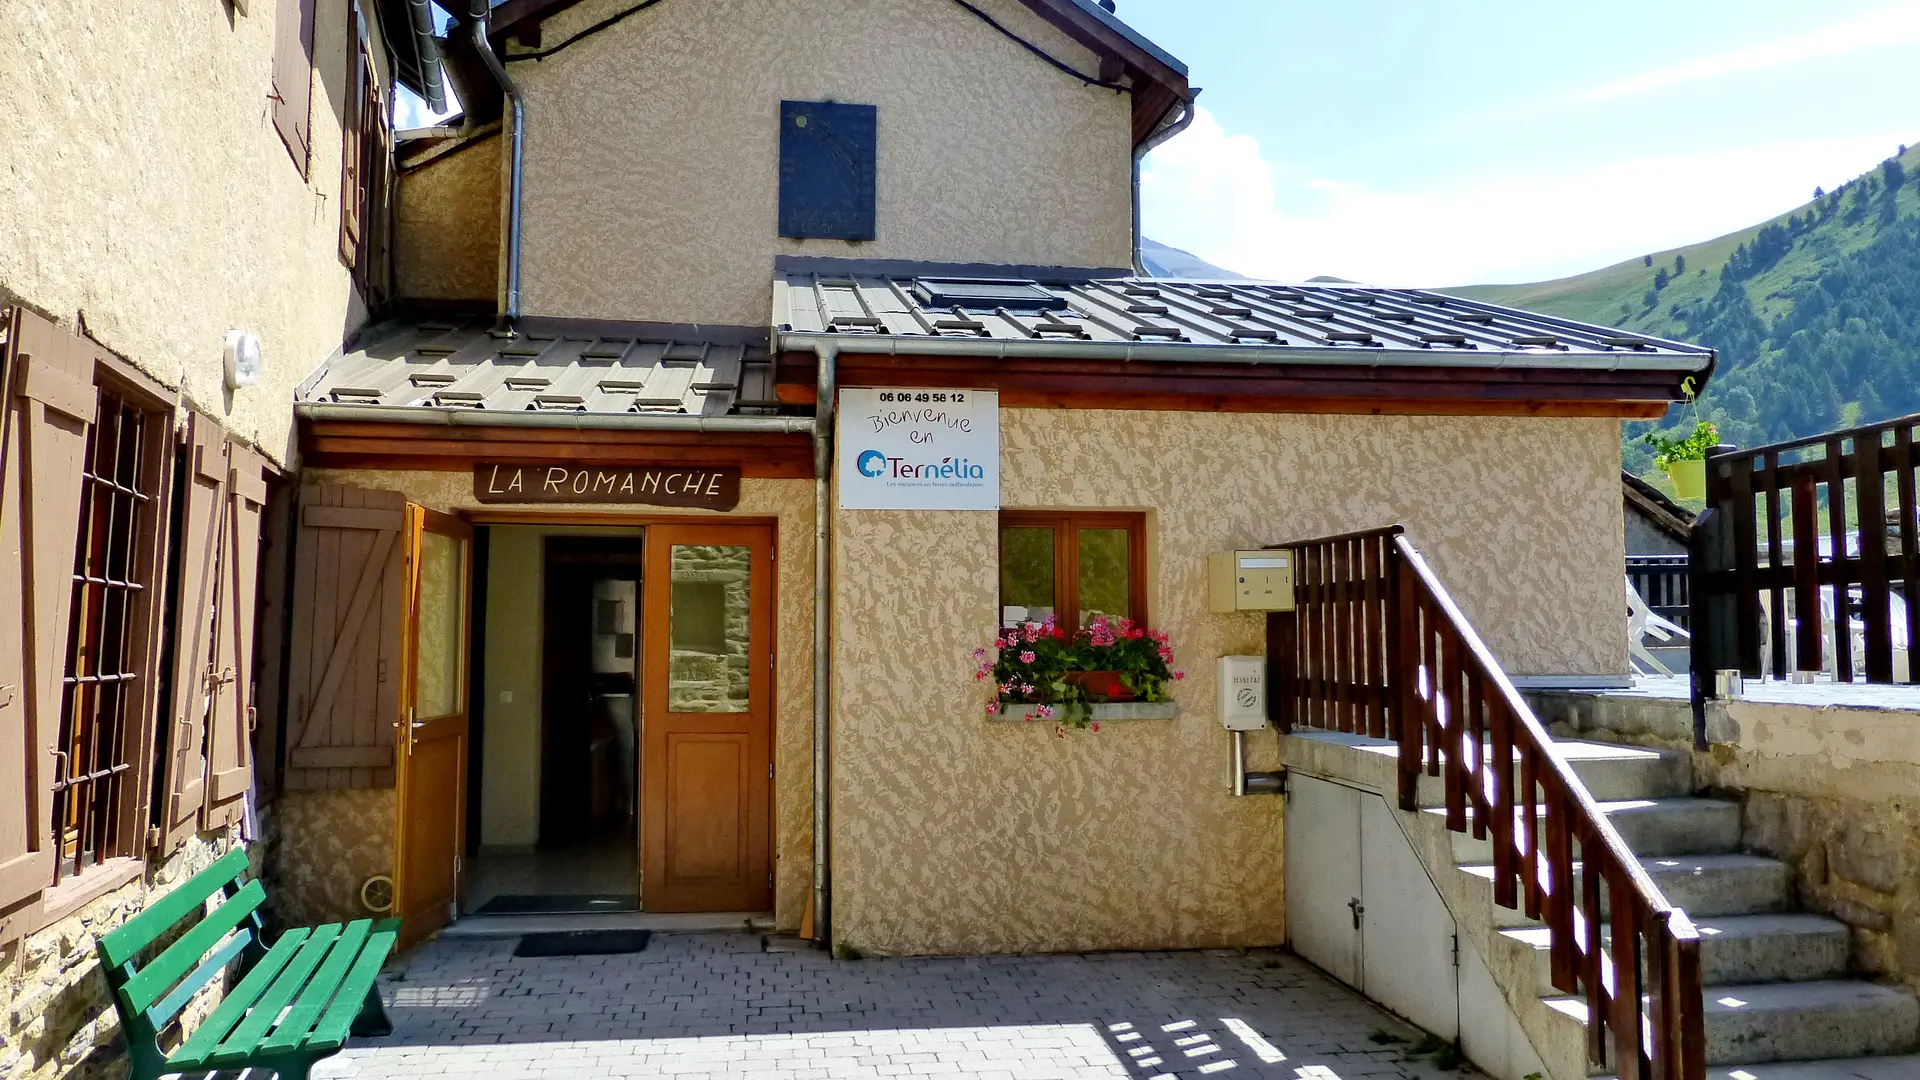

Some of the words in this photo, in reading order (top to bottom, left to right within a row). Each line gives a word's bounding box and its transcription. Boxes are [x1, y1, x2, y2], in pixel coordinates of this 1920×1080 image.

[879, 392, 895, 403] 06
[897, 392, 912, 403] 06
[915, 393, 929, 403] 49
[932, 393, 947, 403] 58
[950, 393, 965, 403] 12
[867, 408, 972, 433] Bienvenue
[909, 430, 934, 444] en
[886, 456, 984, 479] Ternélia
[488, 464, 523, 494] LA
[543, 467, 724, 496] ROMANCHE
